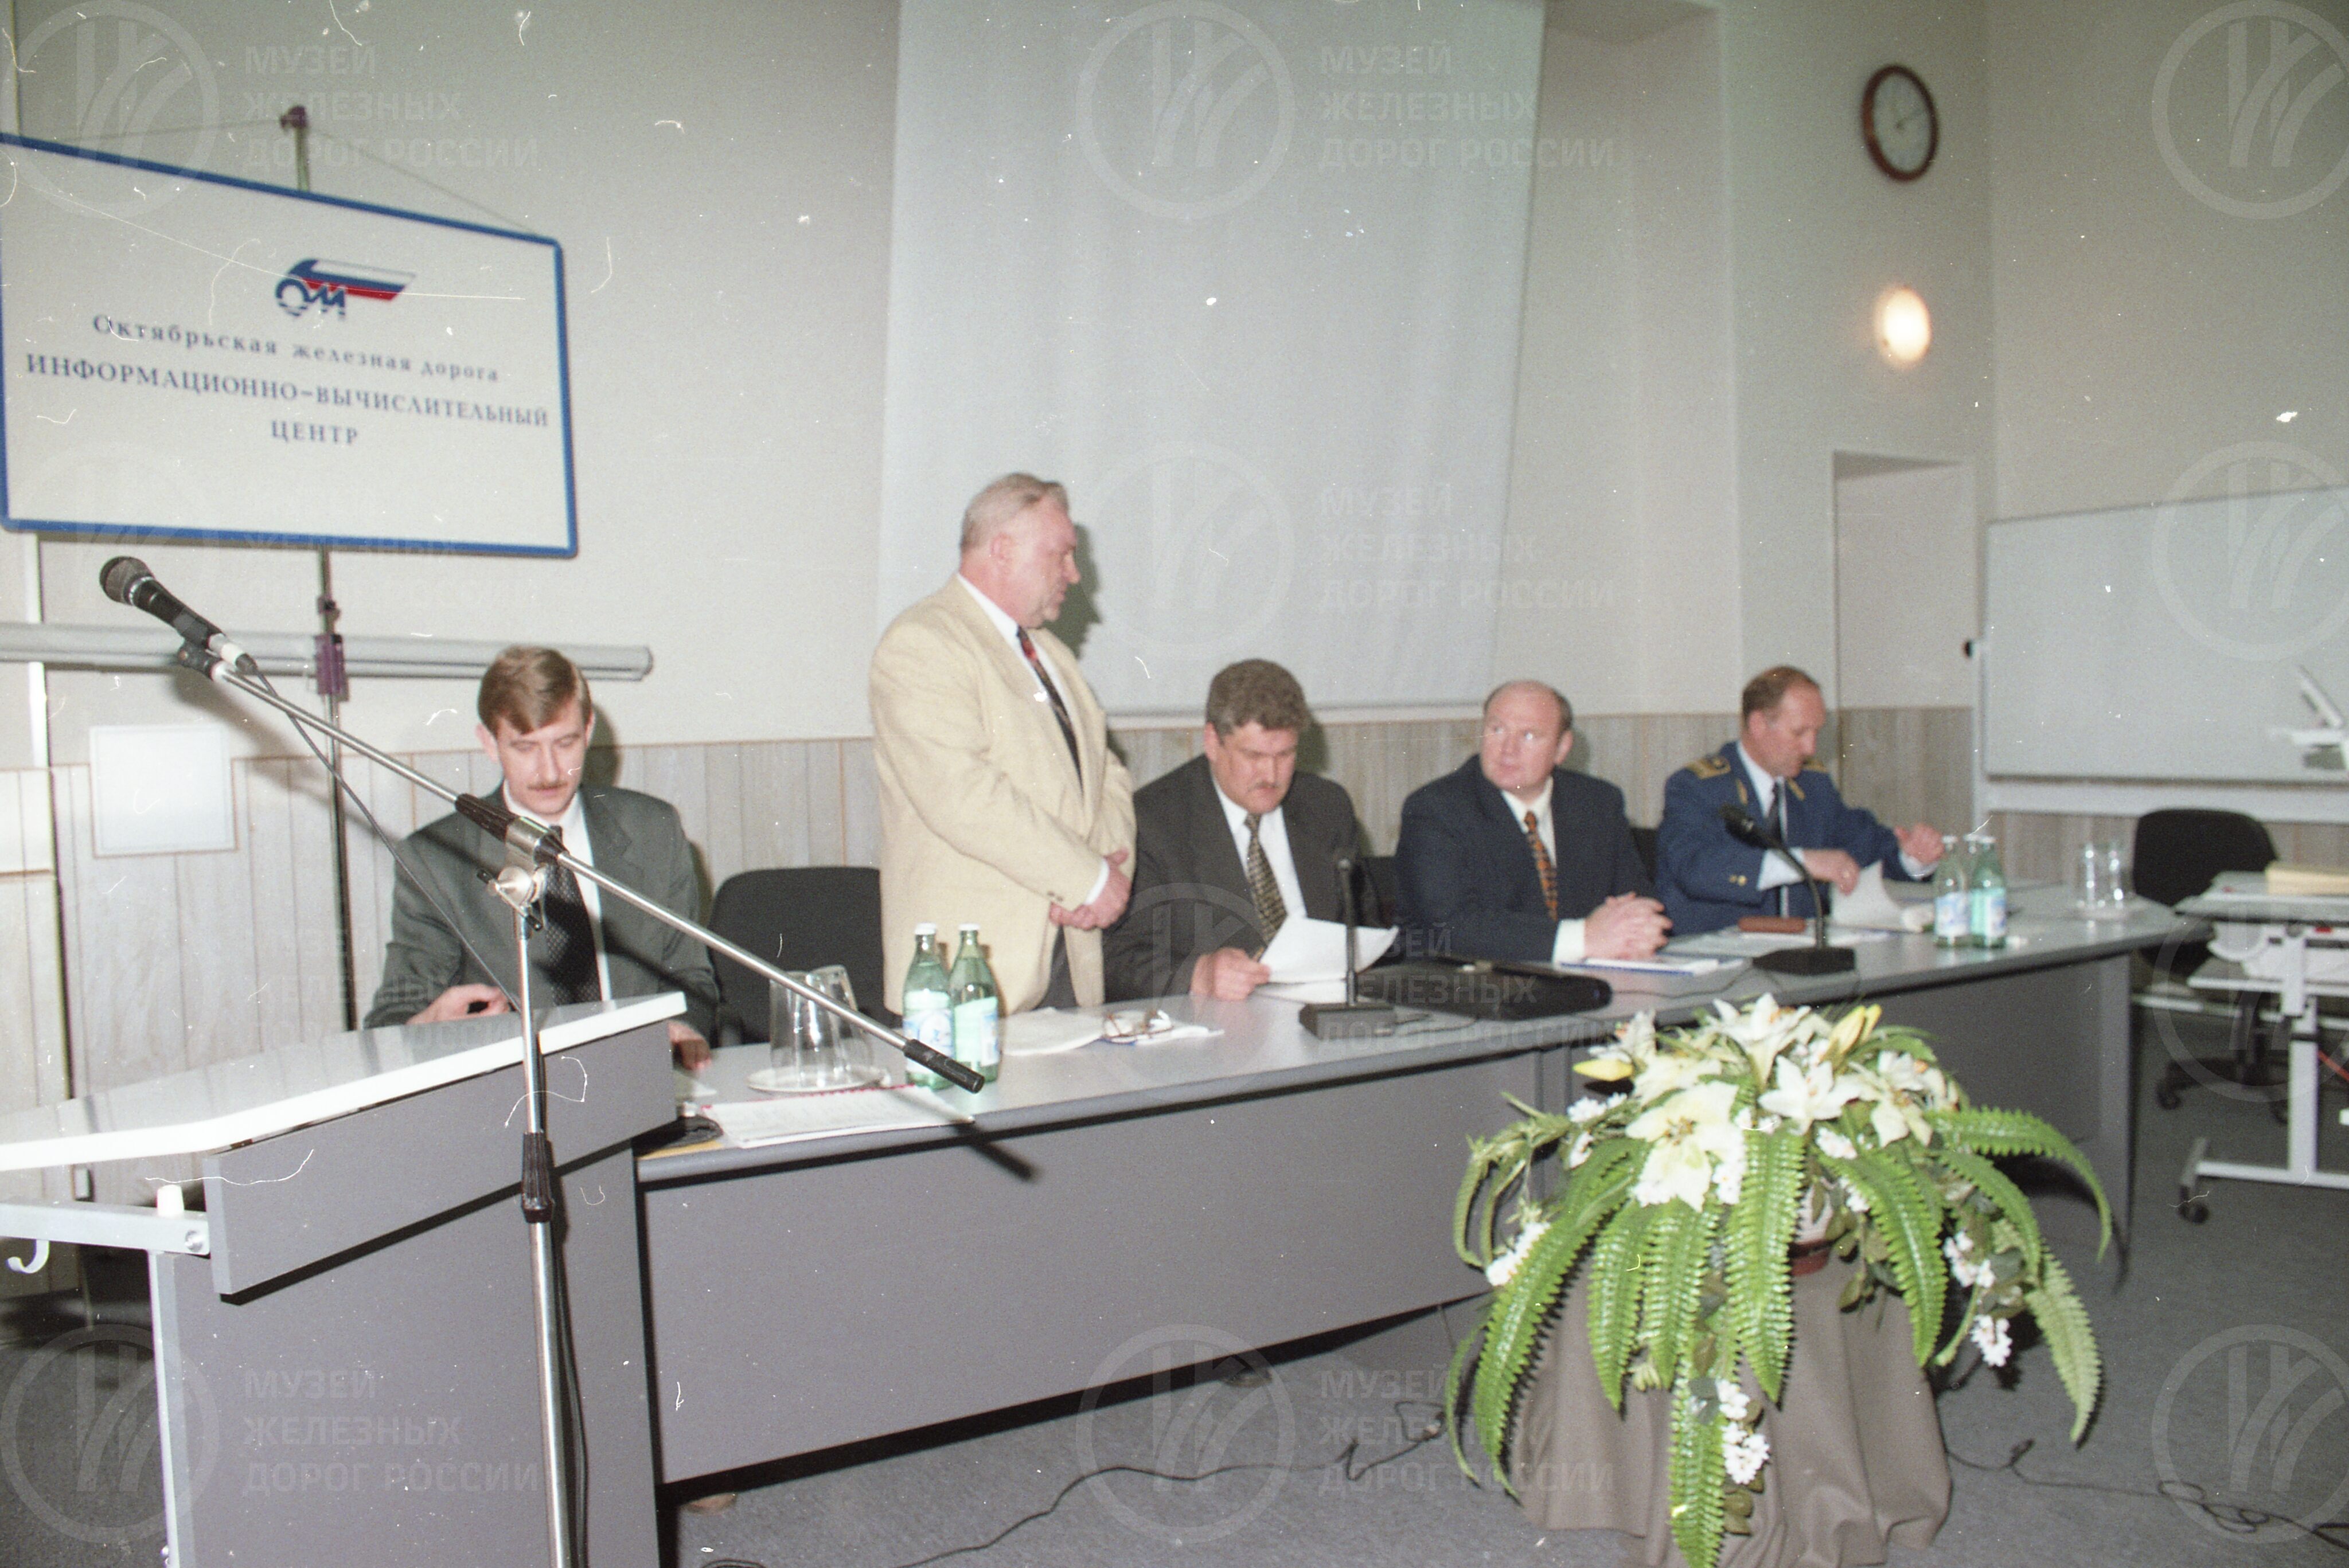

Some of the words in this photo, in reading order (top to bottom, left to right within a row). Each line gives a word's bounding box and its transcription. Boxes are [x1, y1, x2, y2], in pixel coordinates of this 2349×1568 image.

[93, 315, 276, 354] Октябрьская
[292, 345, 412, 372] железная
[420, 361, 499, 381] дорога
[26, 354, 548, 427] ИНФОРМАЦИОННО-ВЫЧИСЛИТЕЛЬНЫЙ
[271, 420, 358, 445] ЦЕНТР
